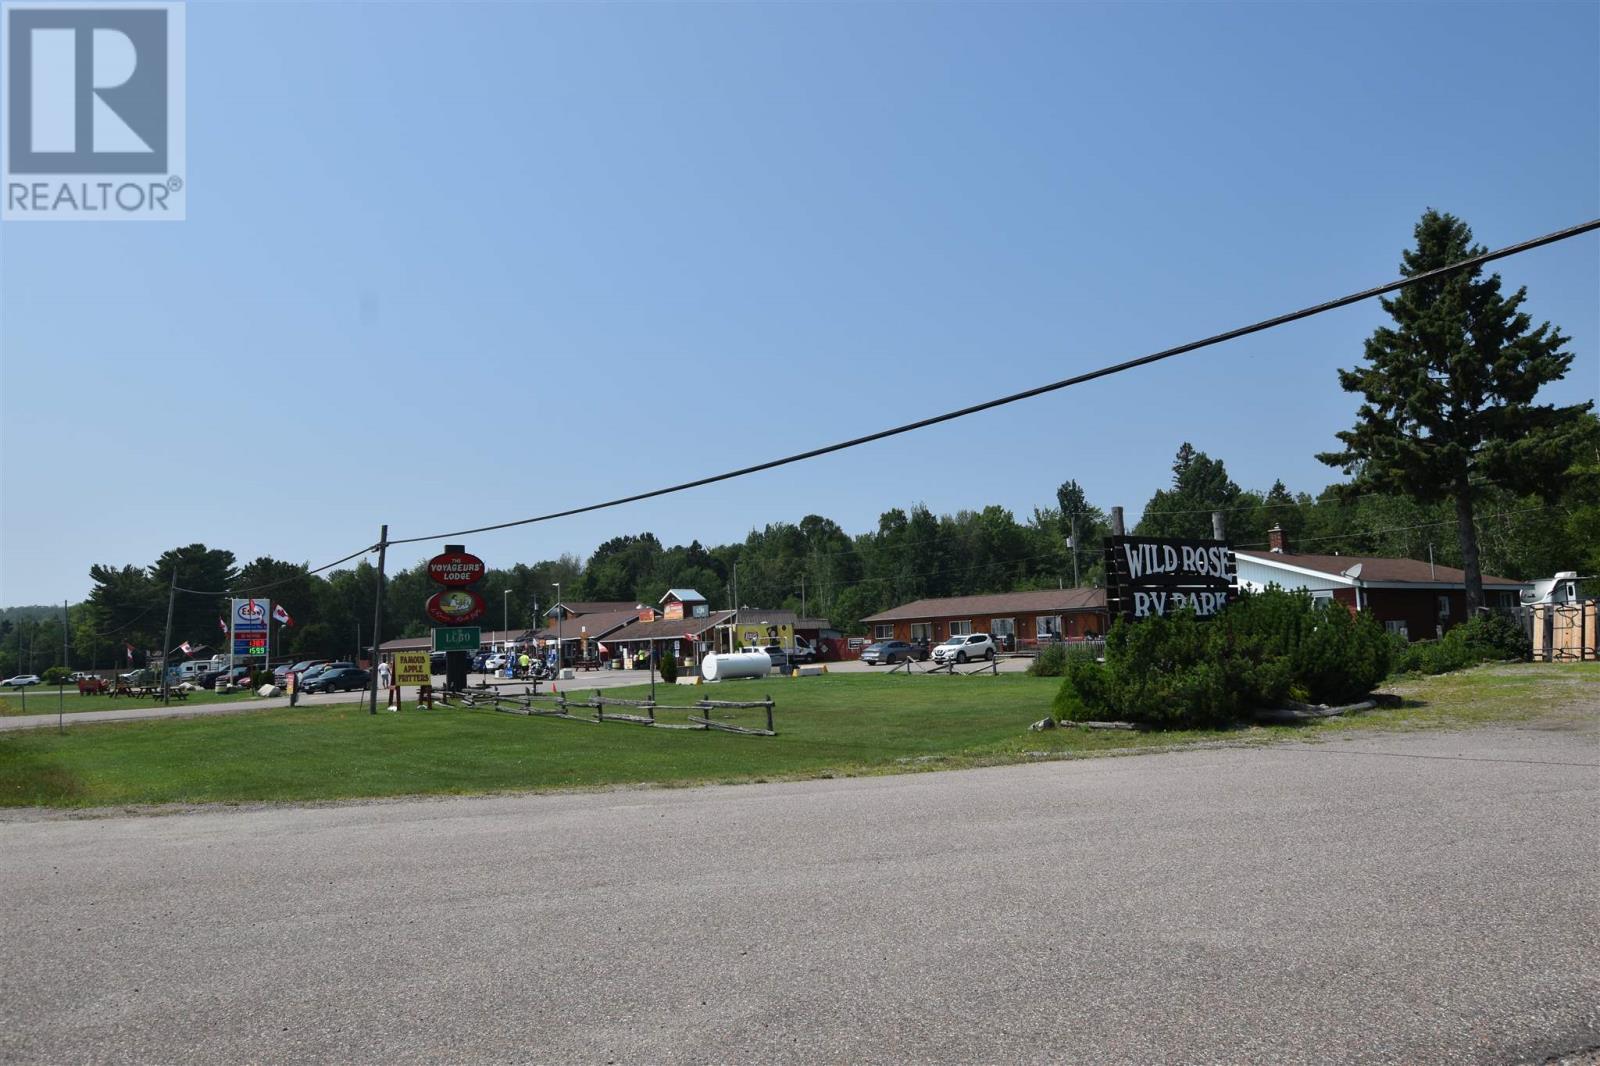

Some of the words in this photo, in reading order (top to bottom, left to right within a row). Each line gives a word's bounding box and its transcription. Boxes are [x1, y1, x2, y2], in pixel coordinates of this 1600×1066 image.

[1123, 543, 1178, 579] WILD
[1181, 546, 1233, 582] ROSE
[444, 572, 471, 580] LODGE
[1133, 592, 1167, 617] RV
[1171, 592, 1228, 616] PARK
[400, 656, 425, 664] FAMOUS
[403, 665, 424, 673] APPLE
